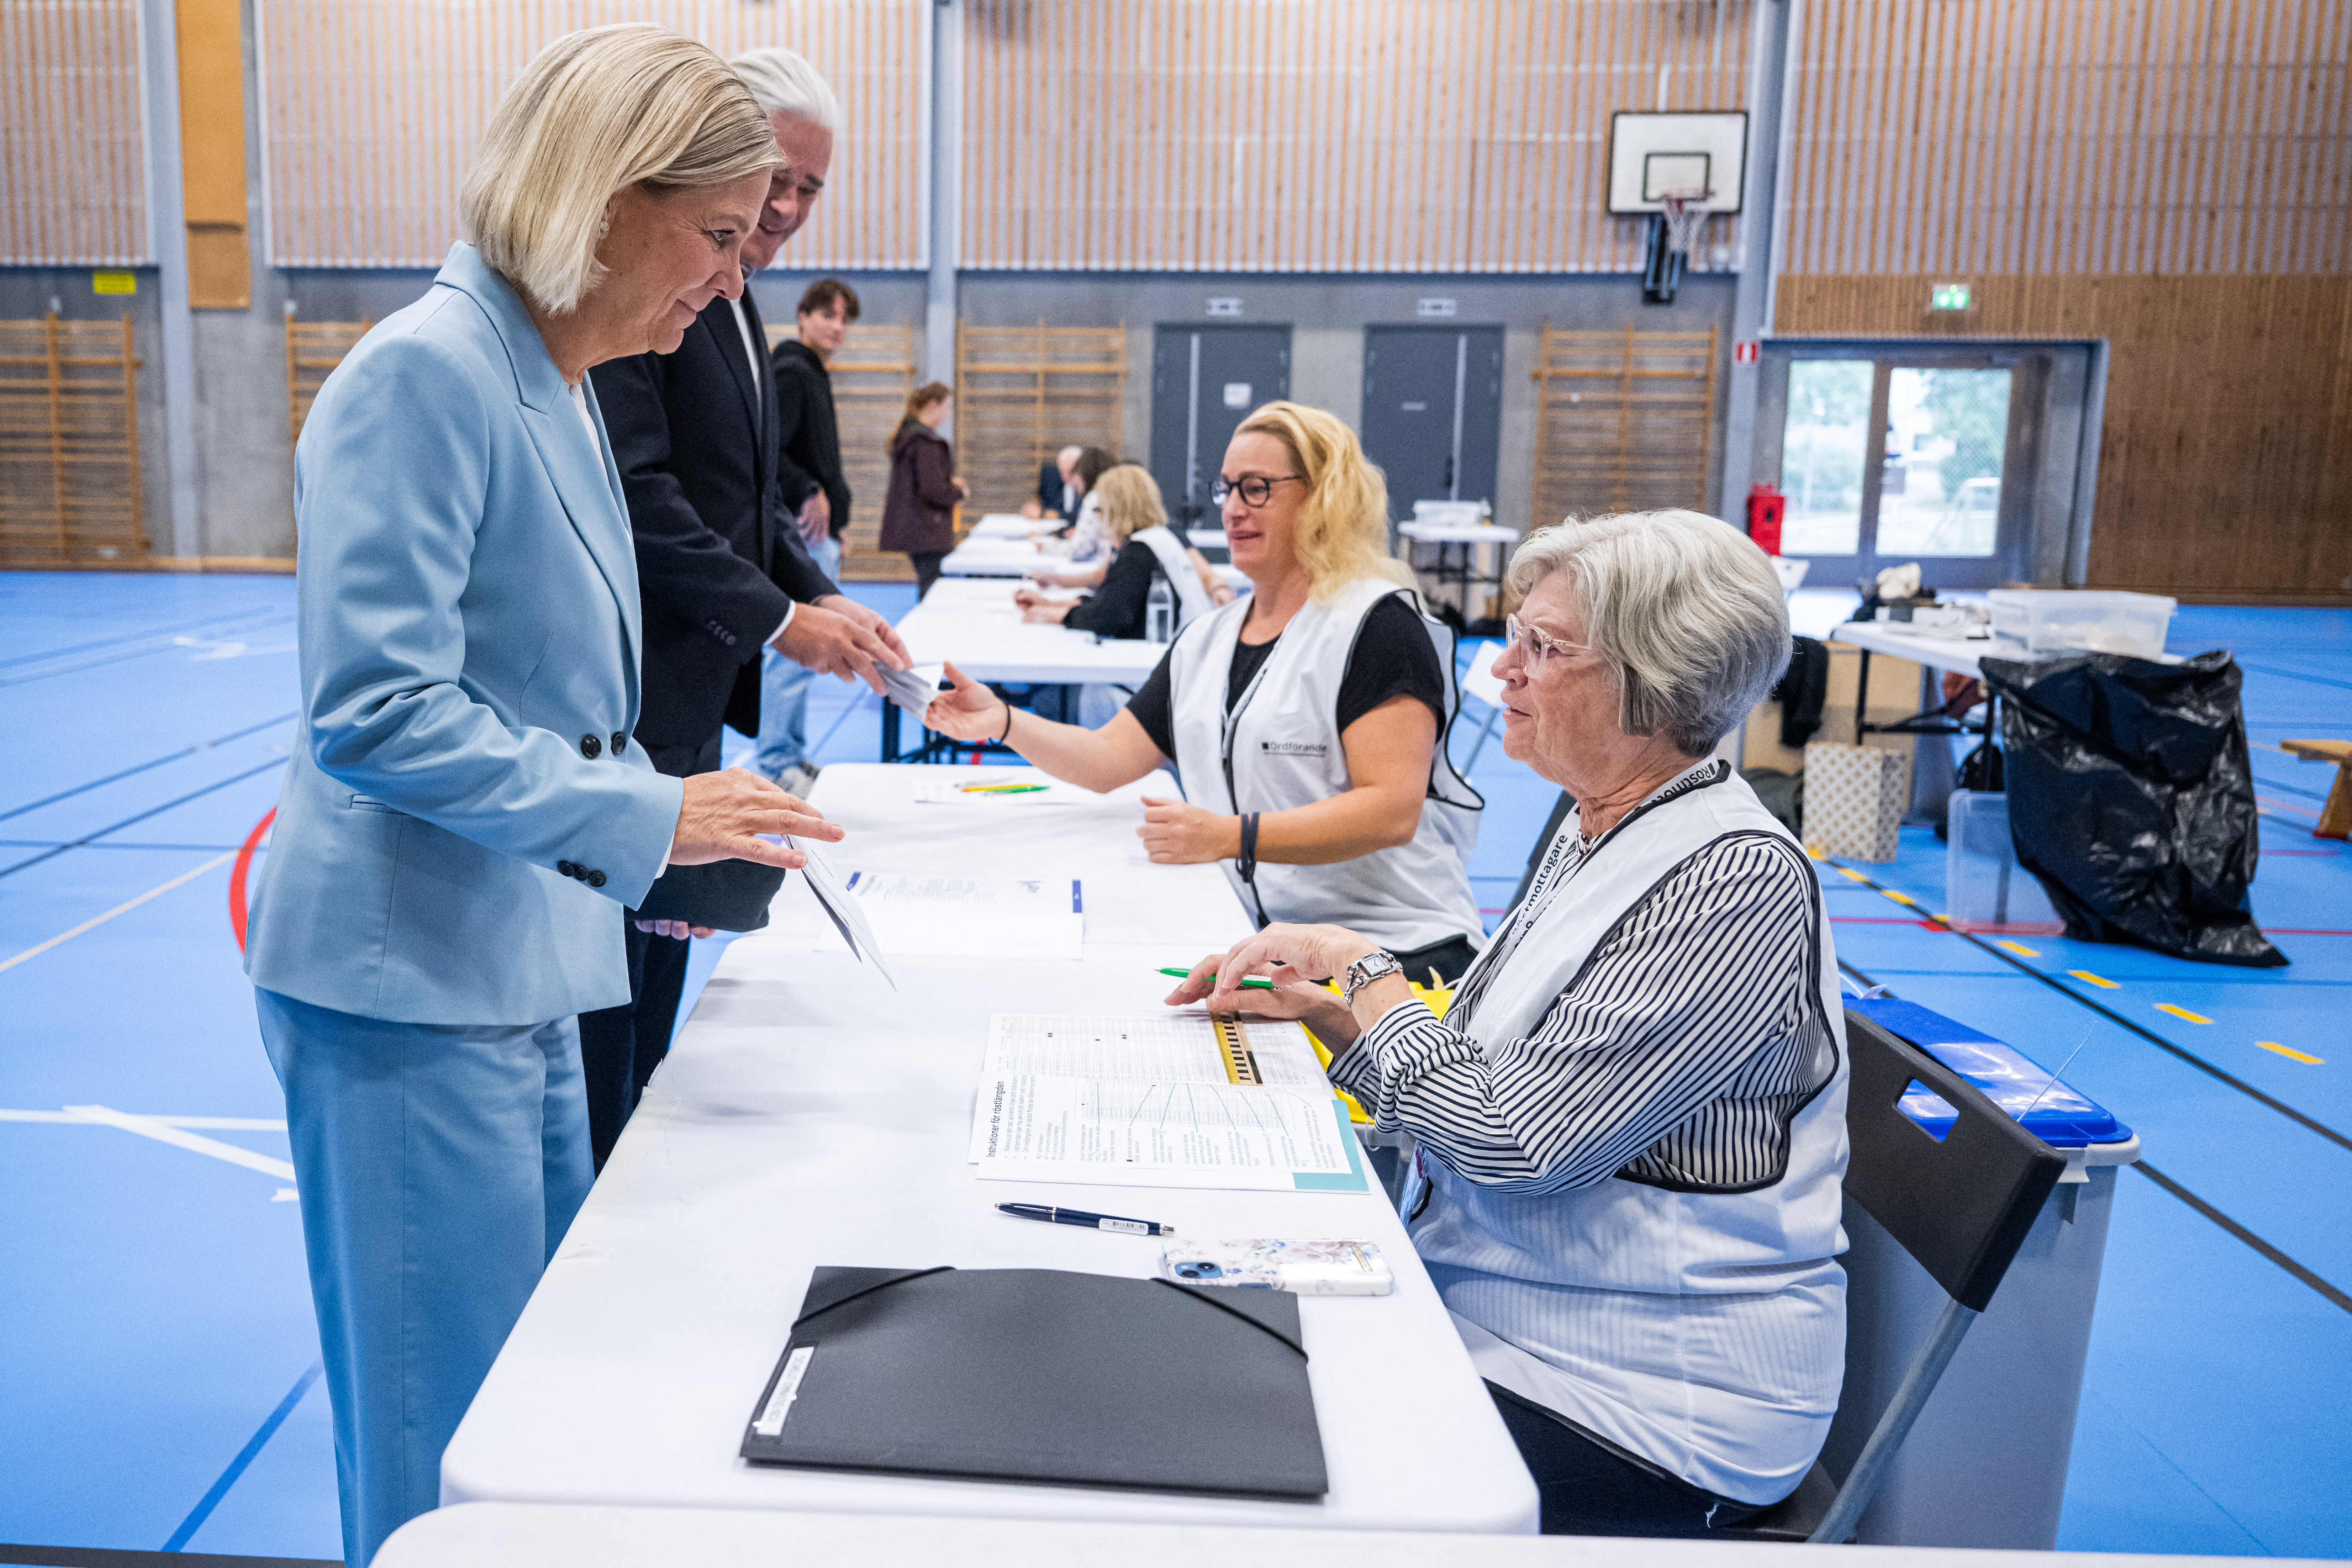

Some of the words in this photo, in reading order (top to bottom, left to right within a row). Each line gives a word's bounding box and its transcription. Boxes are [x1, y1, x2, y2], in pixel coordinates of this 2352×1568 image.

[992, 1081, 1006, 1114] röstlängden
[990, 1115, 1000, 1123] för
[986, 1125, 999, 1157] Instruktioner
[1024, 1128, 1032, 1146] röstlängden
